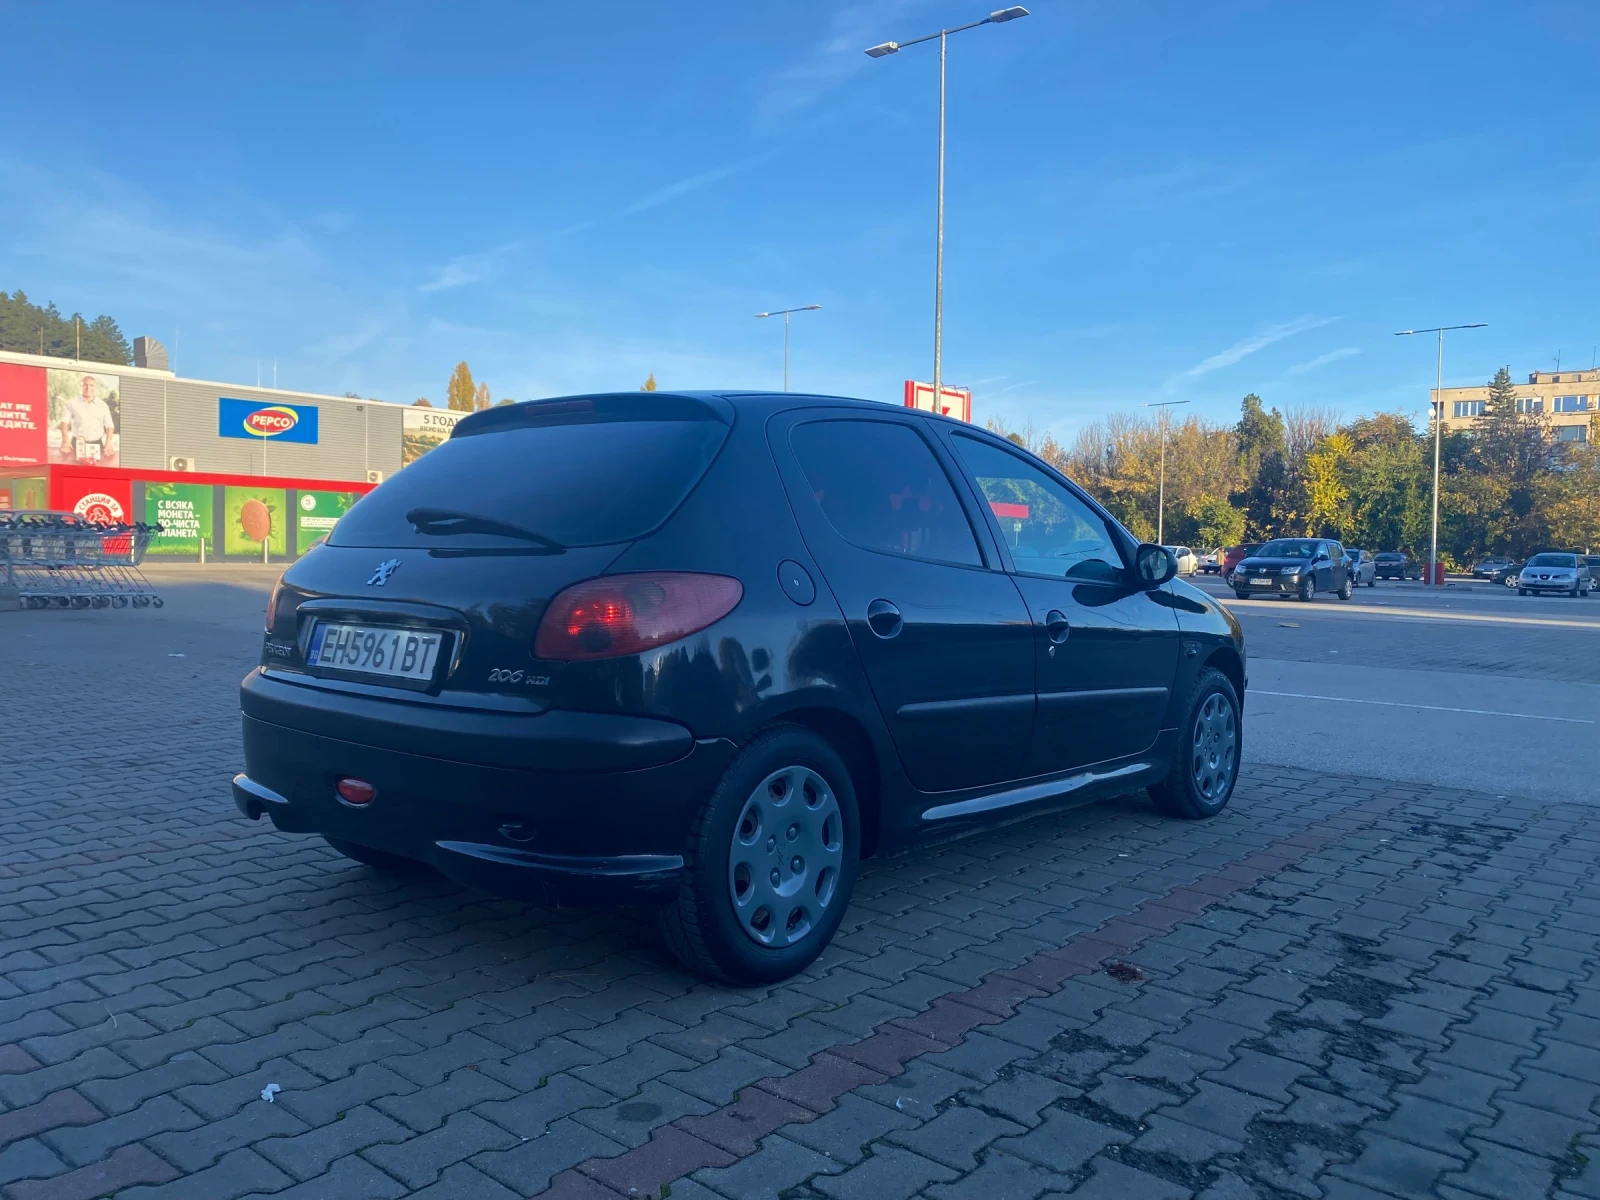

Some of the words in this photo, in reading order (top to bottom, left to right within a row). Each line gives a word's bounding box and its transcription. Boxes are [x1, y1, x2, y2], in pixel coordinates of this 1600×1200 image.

[252, 414, 291, 428] PEPCO
[423, 414, 430, 424] 5
[78, 496, 111, 511] СТАНЦИЯ
[110, 502, 119, 512] ЗА
[157, 500, 164, 509] С
[165, 500, 194, 510] ВСЯКА
[158, 510, 194, 519] МОНЕТА
[158, 519, 200, 529] ПО-ЧИСТА
[487, 668, 524, 683] 206
